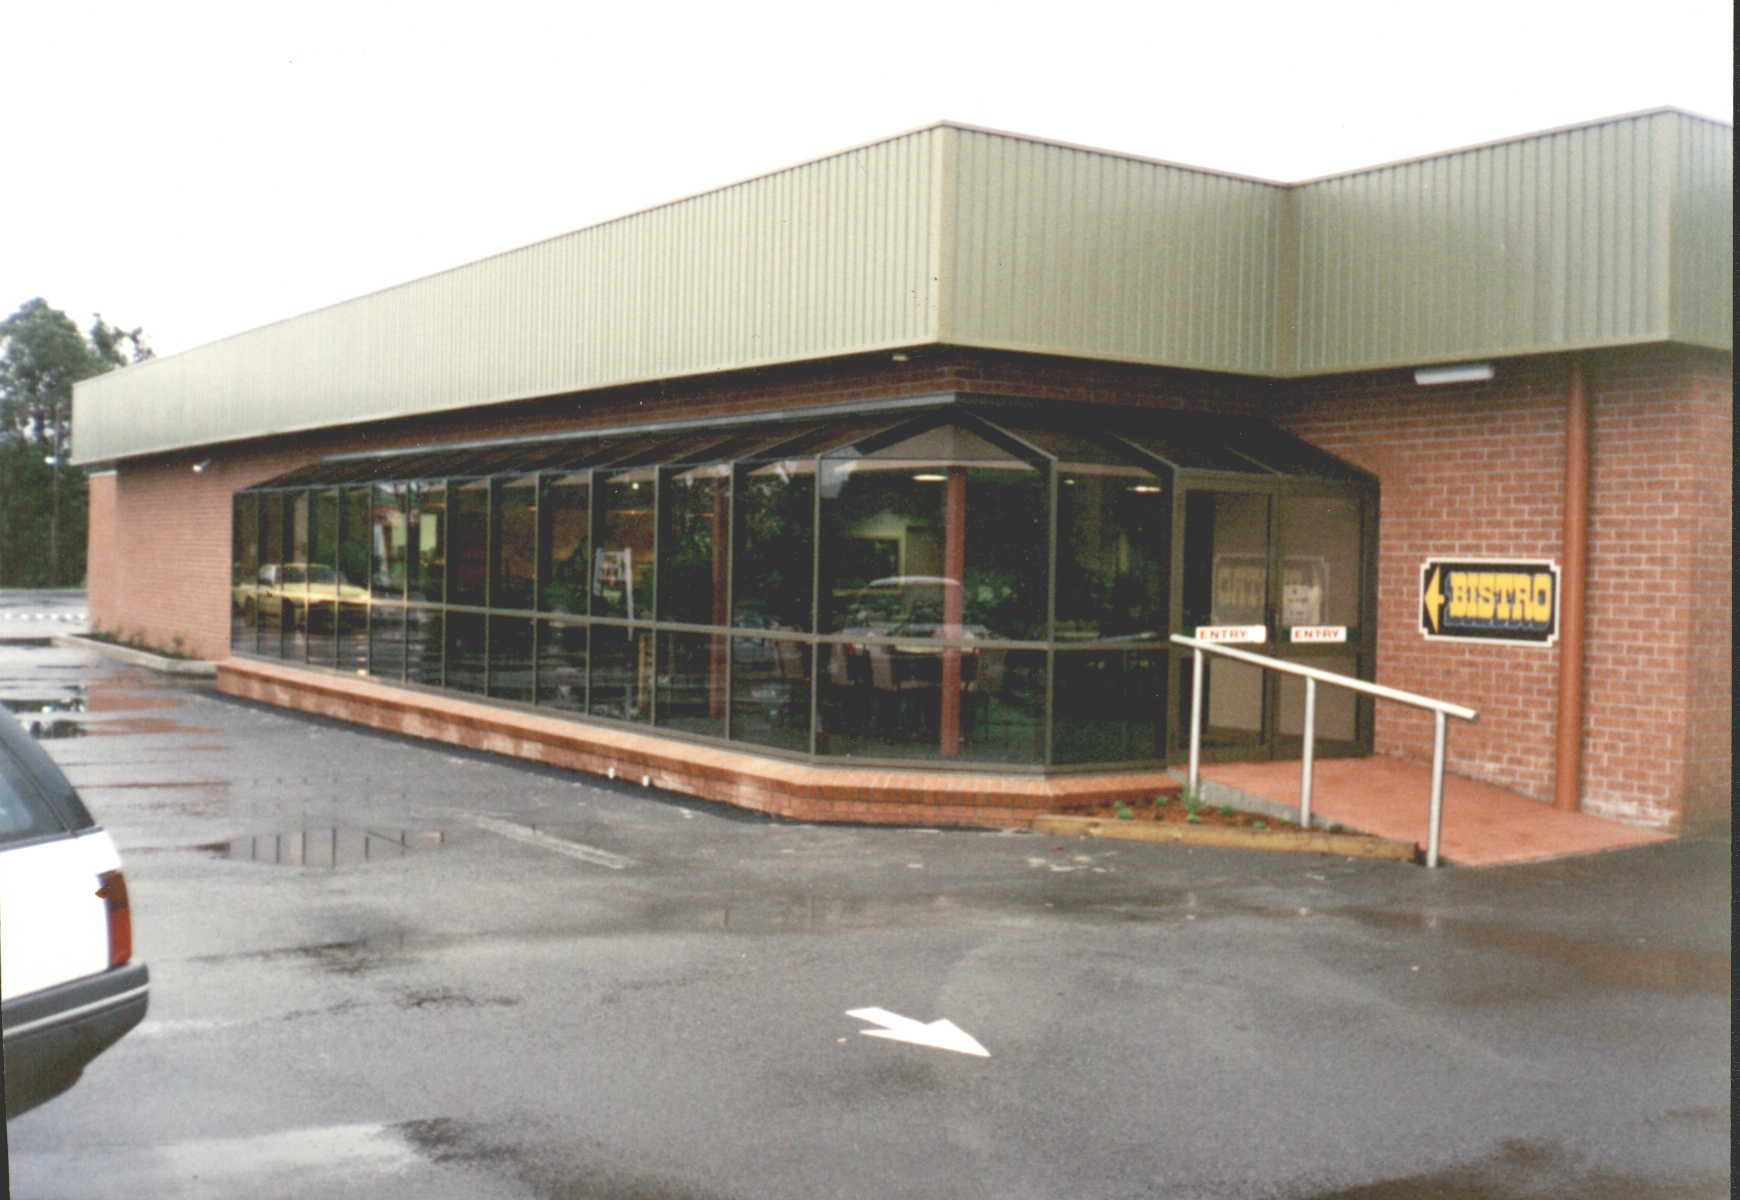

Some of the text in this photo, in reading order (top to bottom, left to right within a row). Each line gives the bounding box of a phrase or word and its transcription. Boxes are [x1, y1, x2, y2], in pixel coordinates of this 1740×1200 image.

[1447, 571, 1552, 625] BISTRO
[1199, 629, 1248, 641] ENTRY
[1294, 629, 1339, 640] ENTRY
